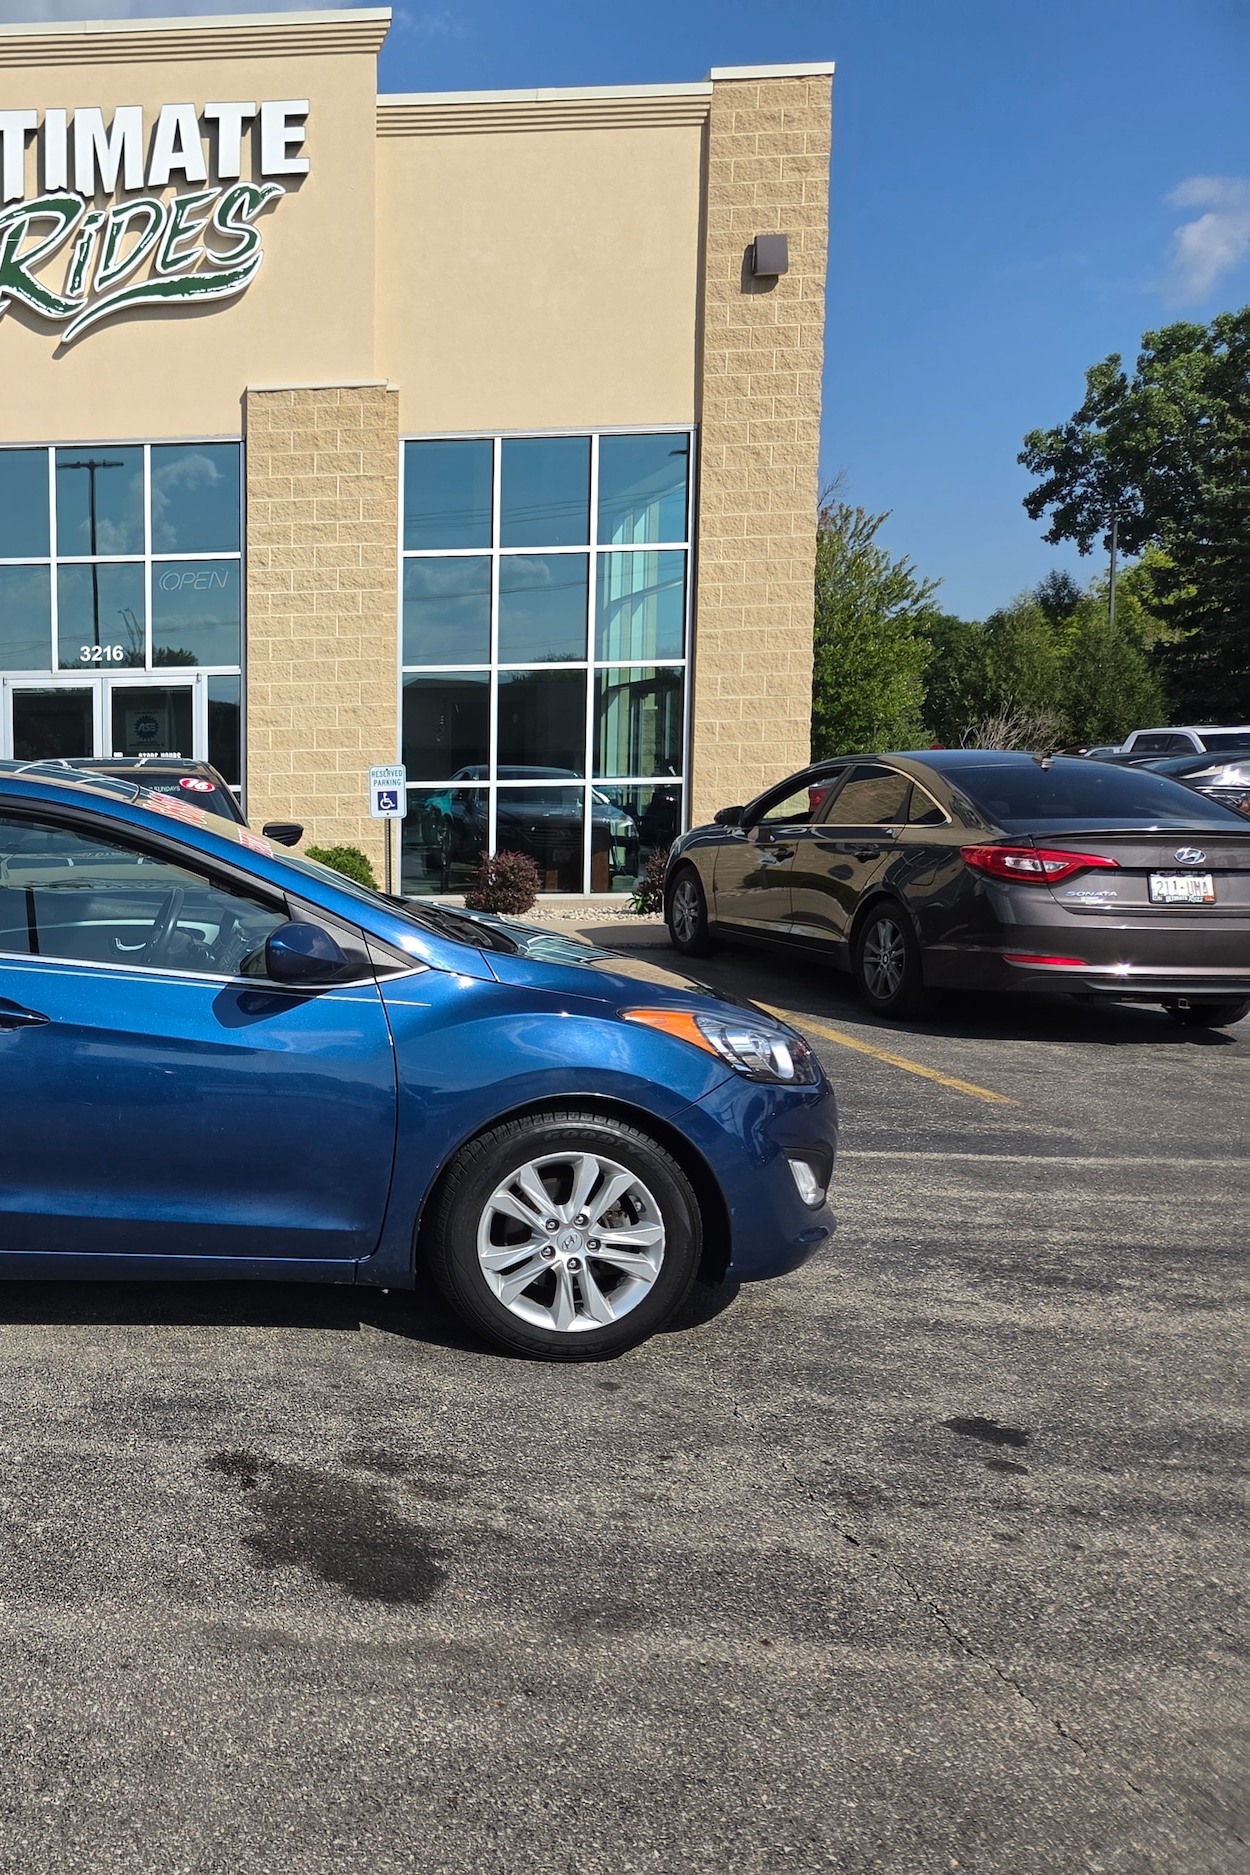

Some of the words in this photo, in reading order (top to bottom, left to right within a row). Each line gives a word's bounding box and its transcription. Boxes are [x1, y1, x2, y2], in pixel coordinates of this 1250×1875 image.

[162, 570, 229, 591] OPEN
[79, 645, 124, 662] 3216
[371, 770, 403, 778] RESERVED
[186, 779, 209, 790] 16
[373, 779, 402, 787] PARKING
